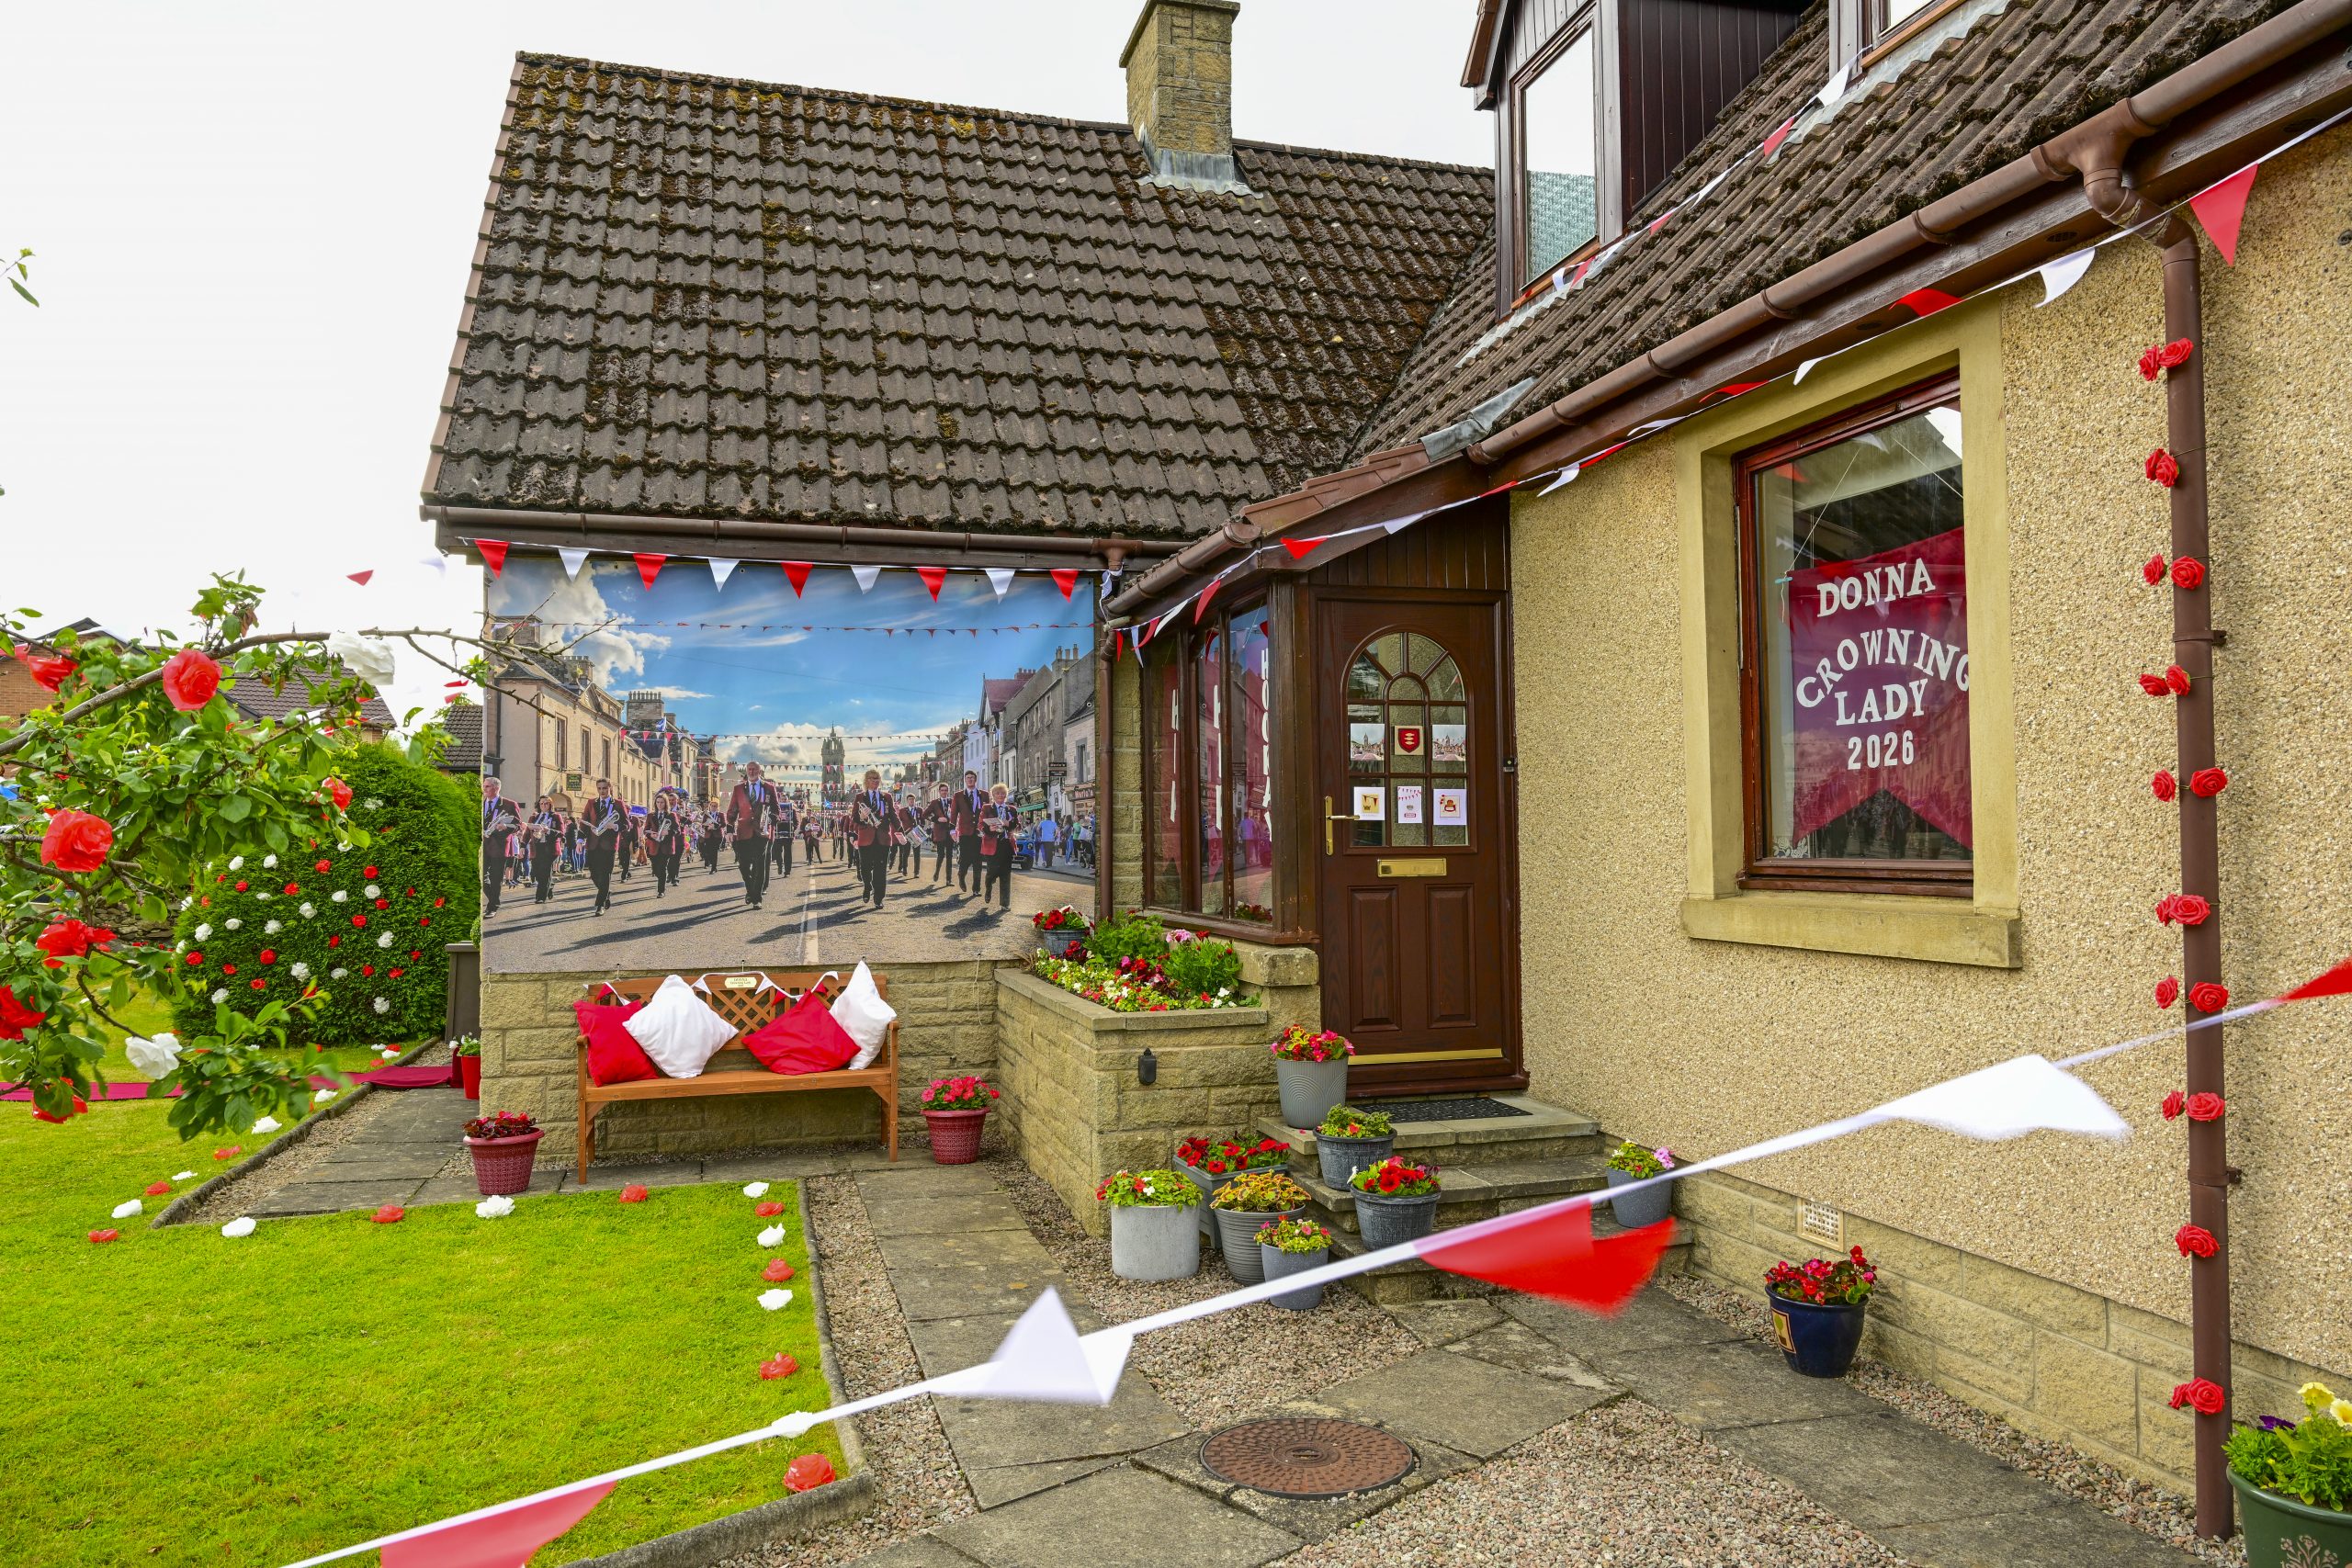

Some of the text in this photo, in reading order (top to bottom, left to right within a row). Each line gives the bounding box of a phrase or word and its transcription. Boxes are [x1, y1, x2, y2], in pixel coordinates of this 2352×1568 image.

[1816, 558, 1936, 618] DONNA
[1796, 627, 1969, 707] CROWNING
[1834, 678, 1928, 726] LADY
[1848, 729, 1914, 771] 2026
